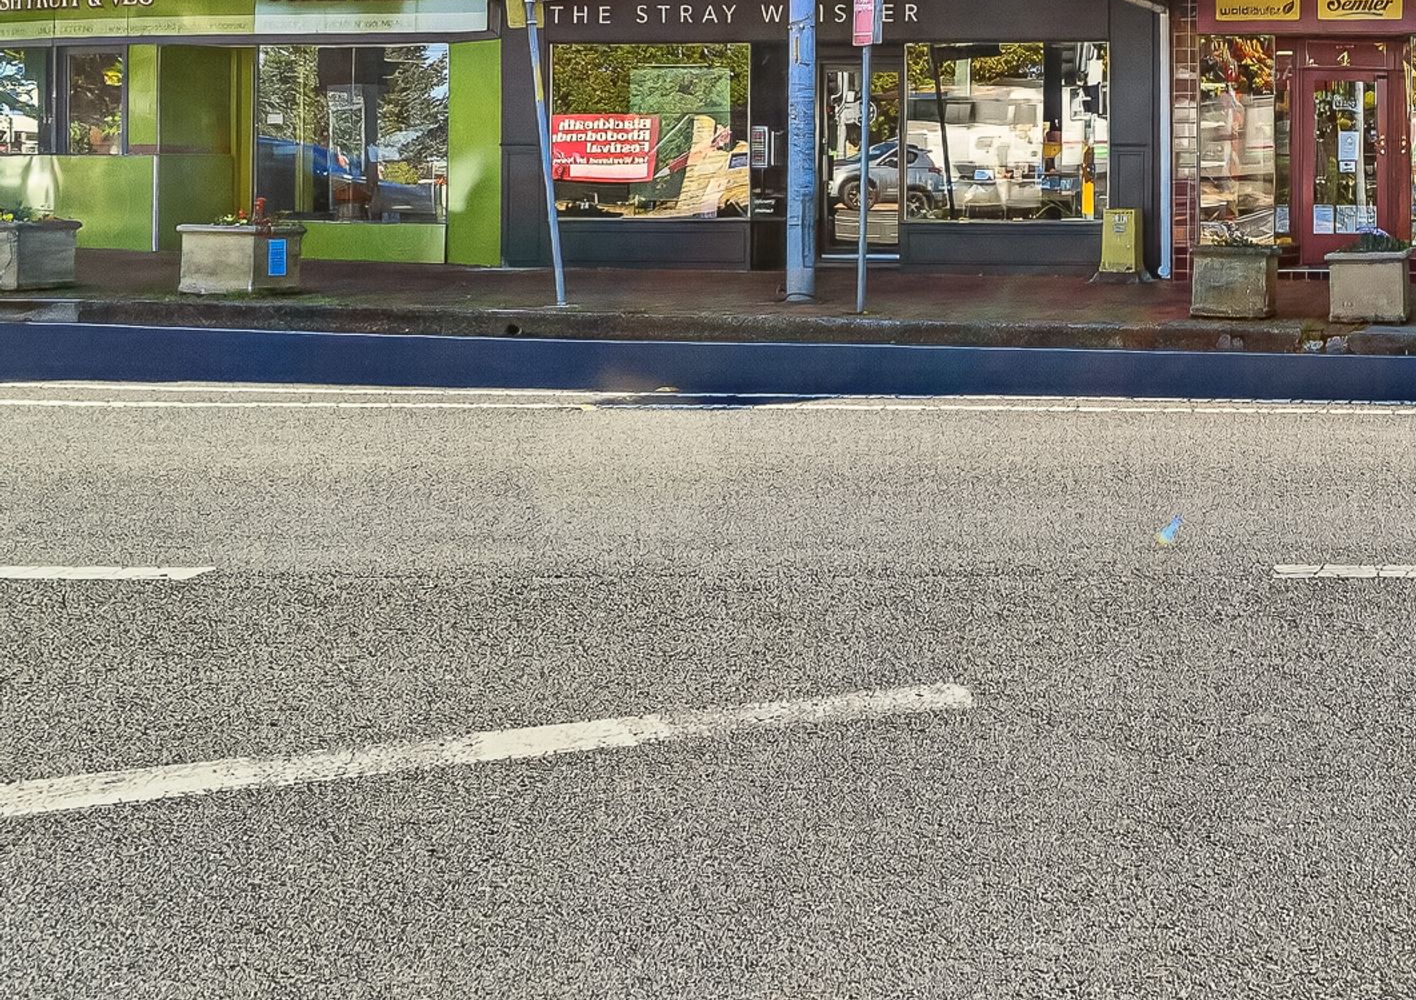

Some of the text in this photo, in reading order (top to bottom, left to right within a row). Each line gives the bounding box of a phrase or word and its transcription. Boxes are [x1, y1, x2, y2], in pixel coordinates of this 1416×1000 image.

[549, 3, 919, 24] THE STRAY WISER
